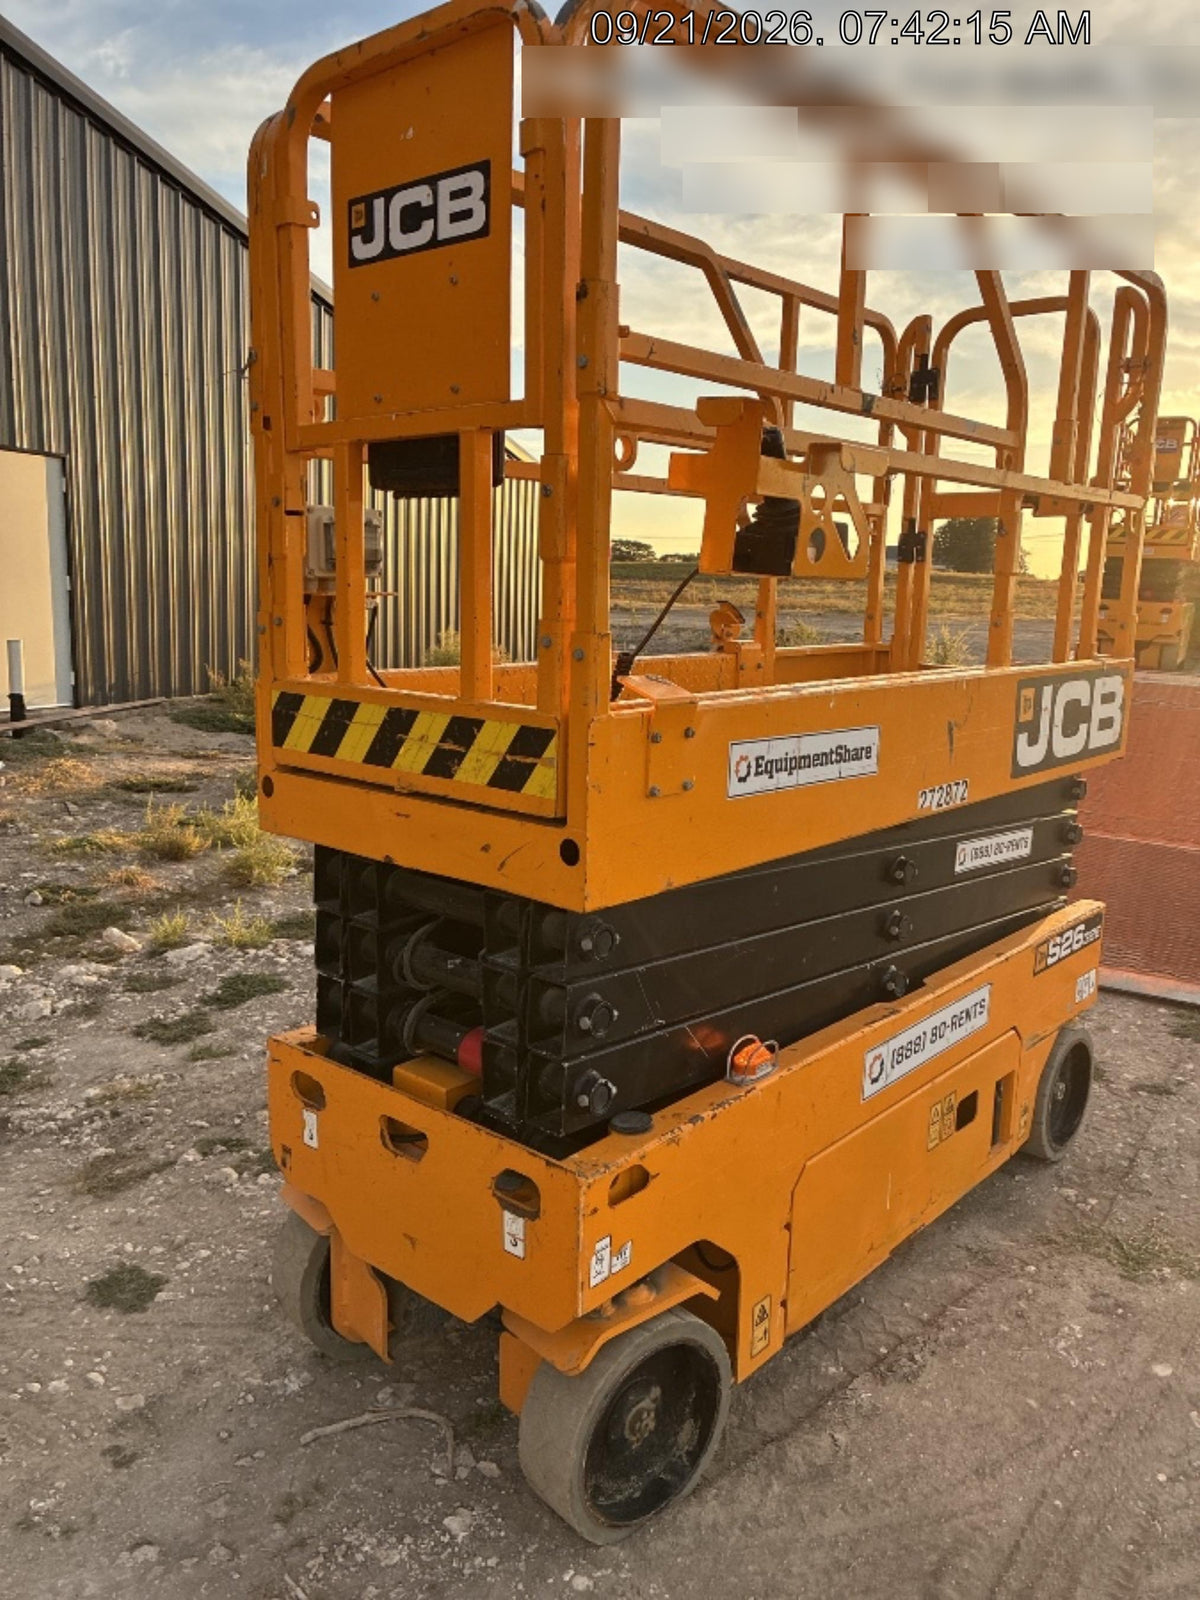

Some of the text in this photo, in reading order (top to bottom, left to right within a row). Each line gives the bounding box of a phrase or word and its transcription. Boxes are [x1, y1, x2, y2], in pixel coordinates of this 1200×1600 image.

[351, 170, 486, 260] JCB
[753, 743, 873, 779] EquipmentShare
[1017, 675, 1125, 768] JCB
[890, 998, 986, 1069] (888) 80-RENTS
